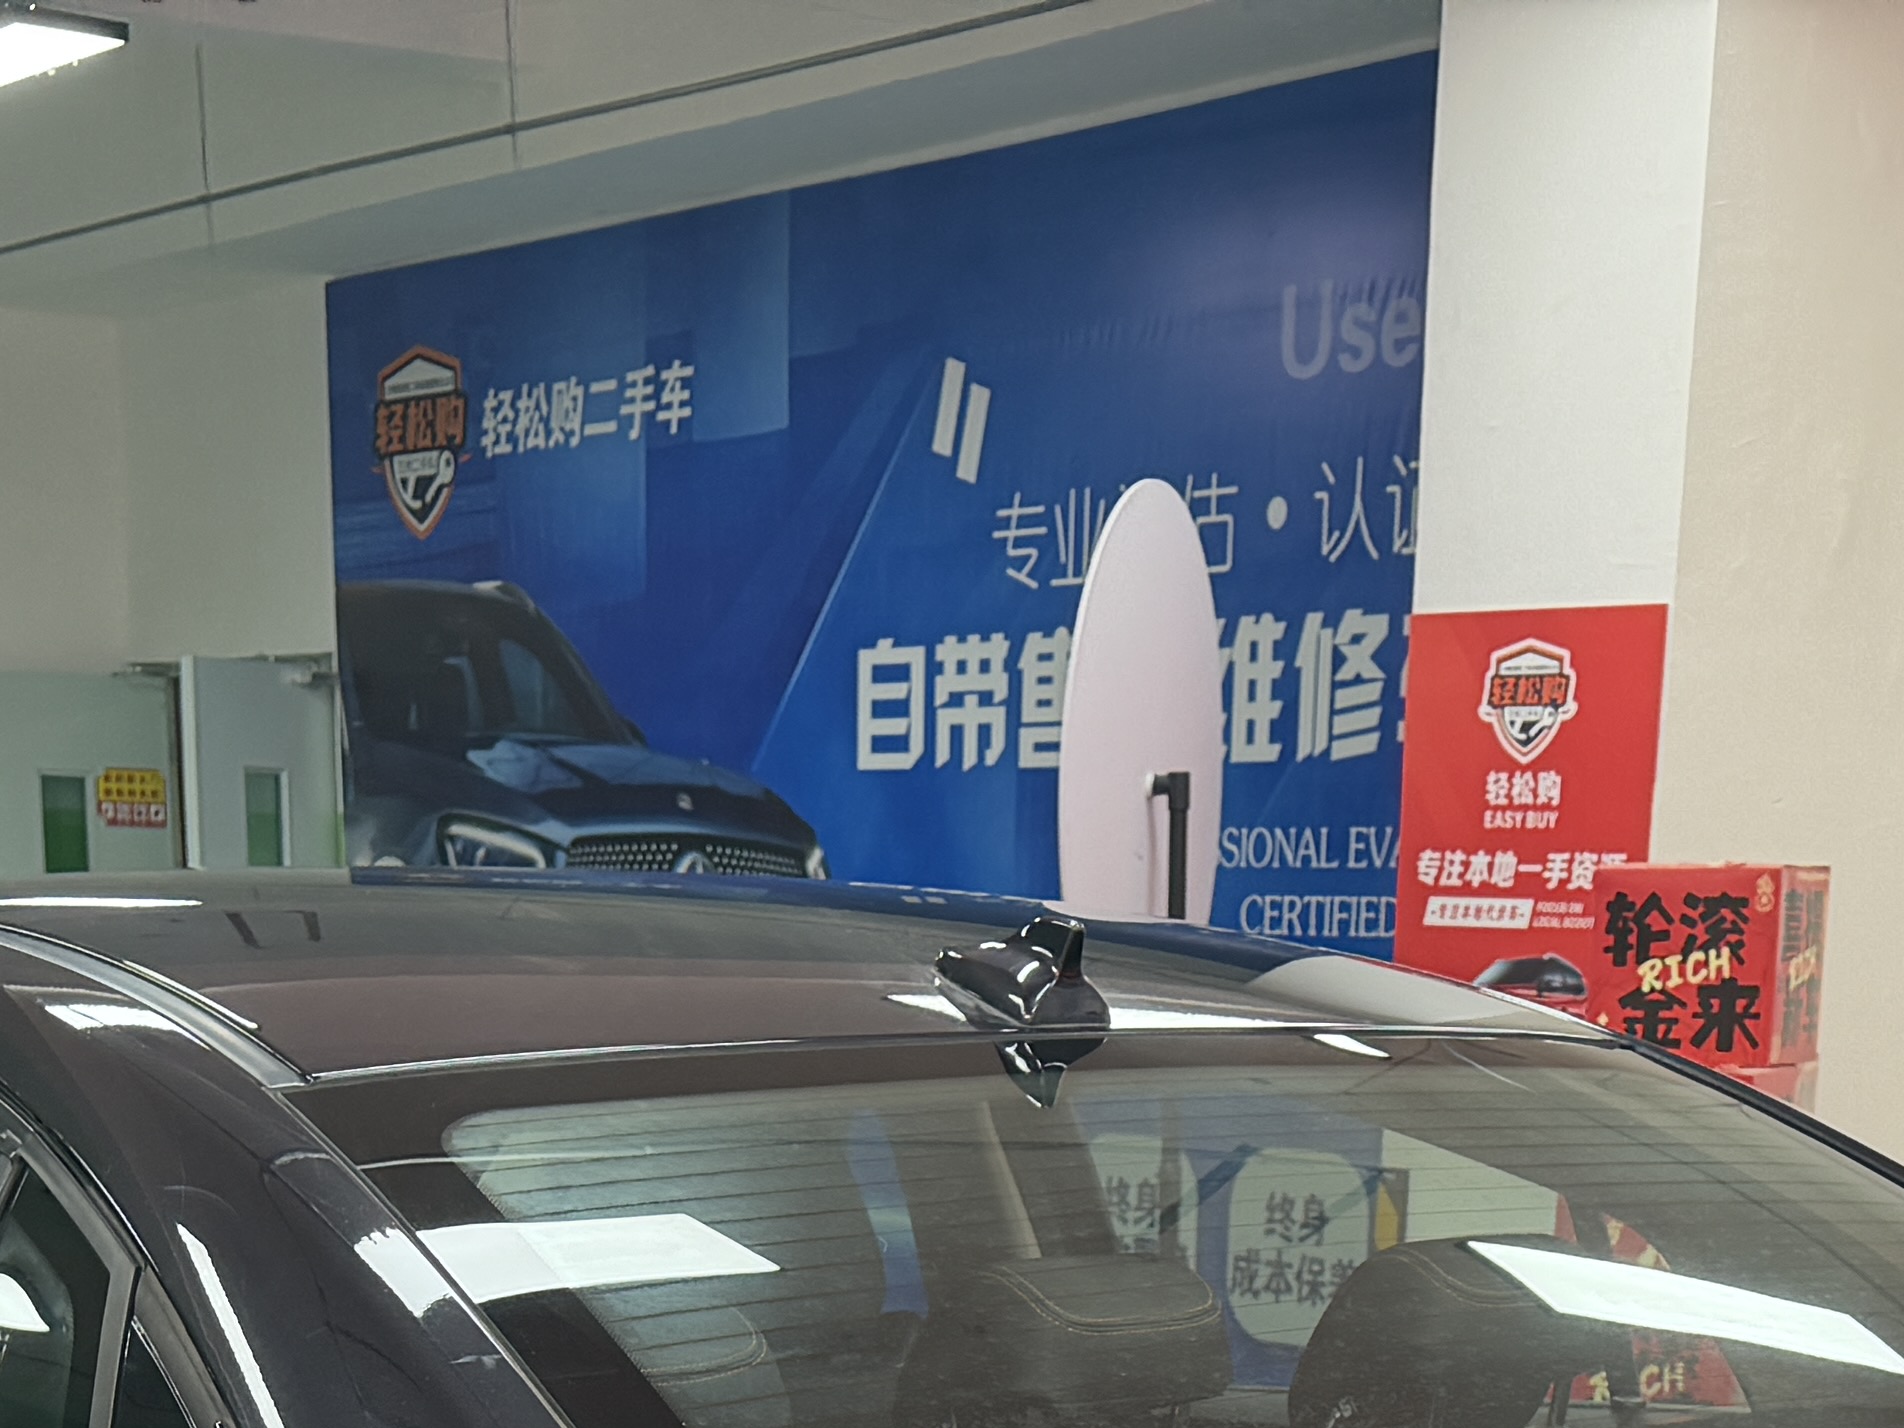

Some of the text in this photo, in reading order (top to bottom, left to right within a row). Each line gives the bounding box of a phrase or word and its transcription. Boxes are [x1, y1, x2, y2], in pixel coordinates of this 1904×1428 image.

[376, 396, 465, 455] 轻松购
[480, 359, 695, 459] 轻松购二手车
[857, 607, 1411, 772] 自带售维修
[1492, 676, 1567, 705] 轻松购
[1484, 770, 1562, 806] 轻松购
[1483, 809, 1559, 829] EASY BUY
[1219, 827, 1339, 868] SIONAL
[1239, 893, 1397, 937] CERTIFIED
[1637, 946, 1731, 993] RICH
[1263, 1190, 1329, 1246] 终身
